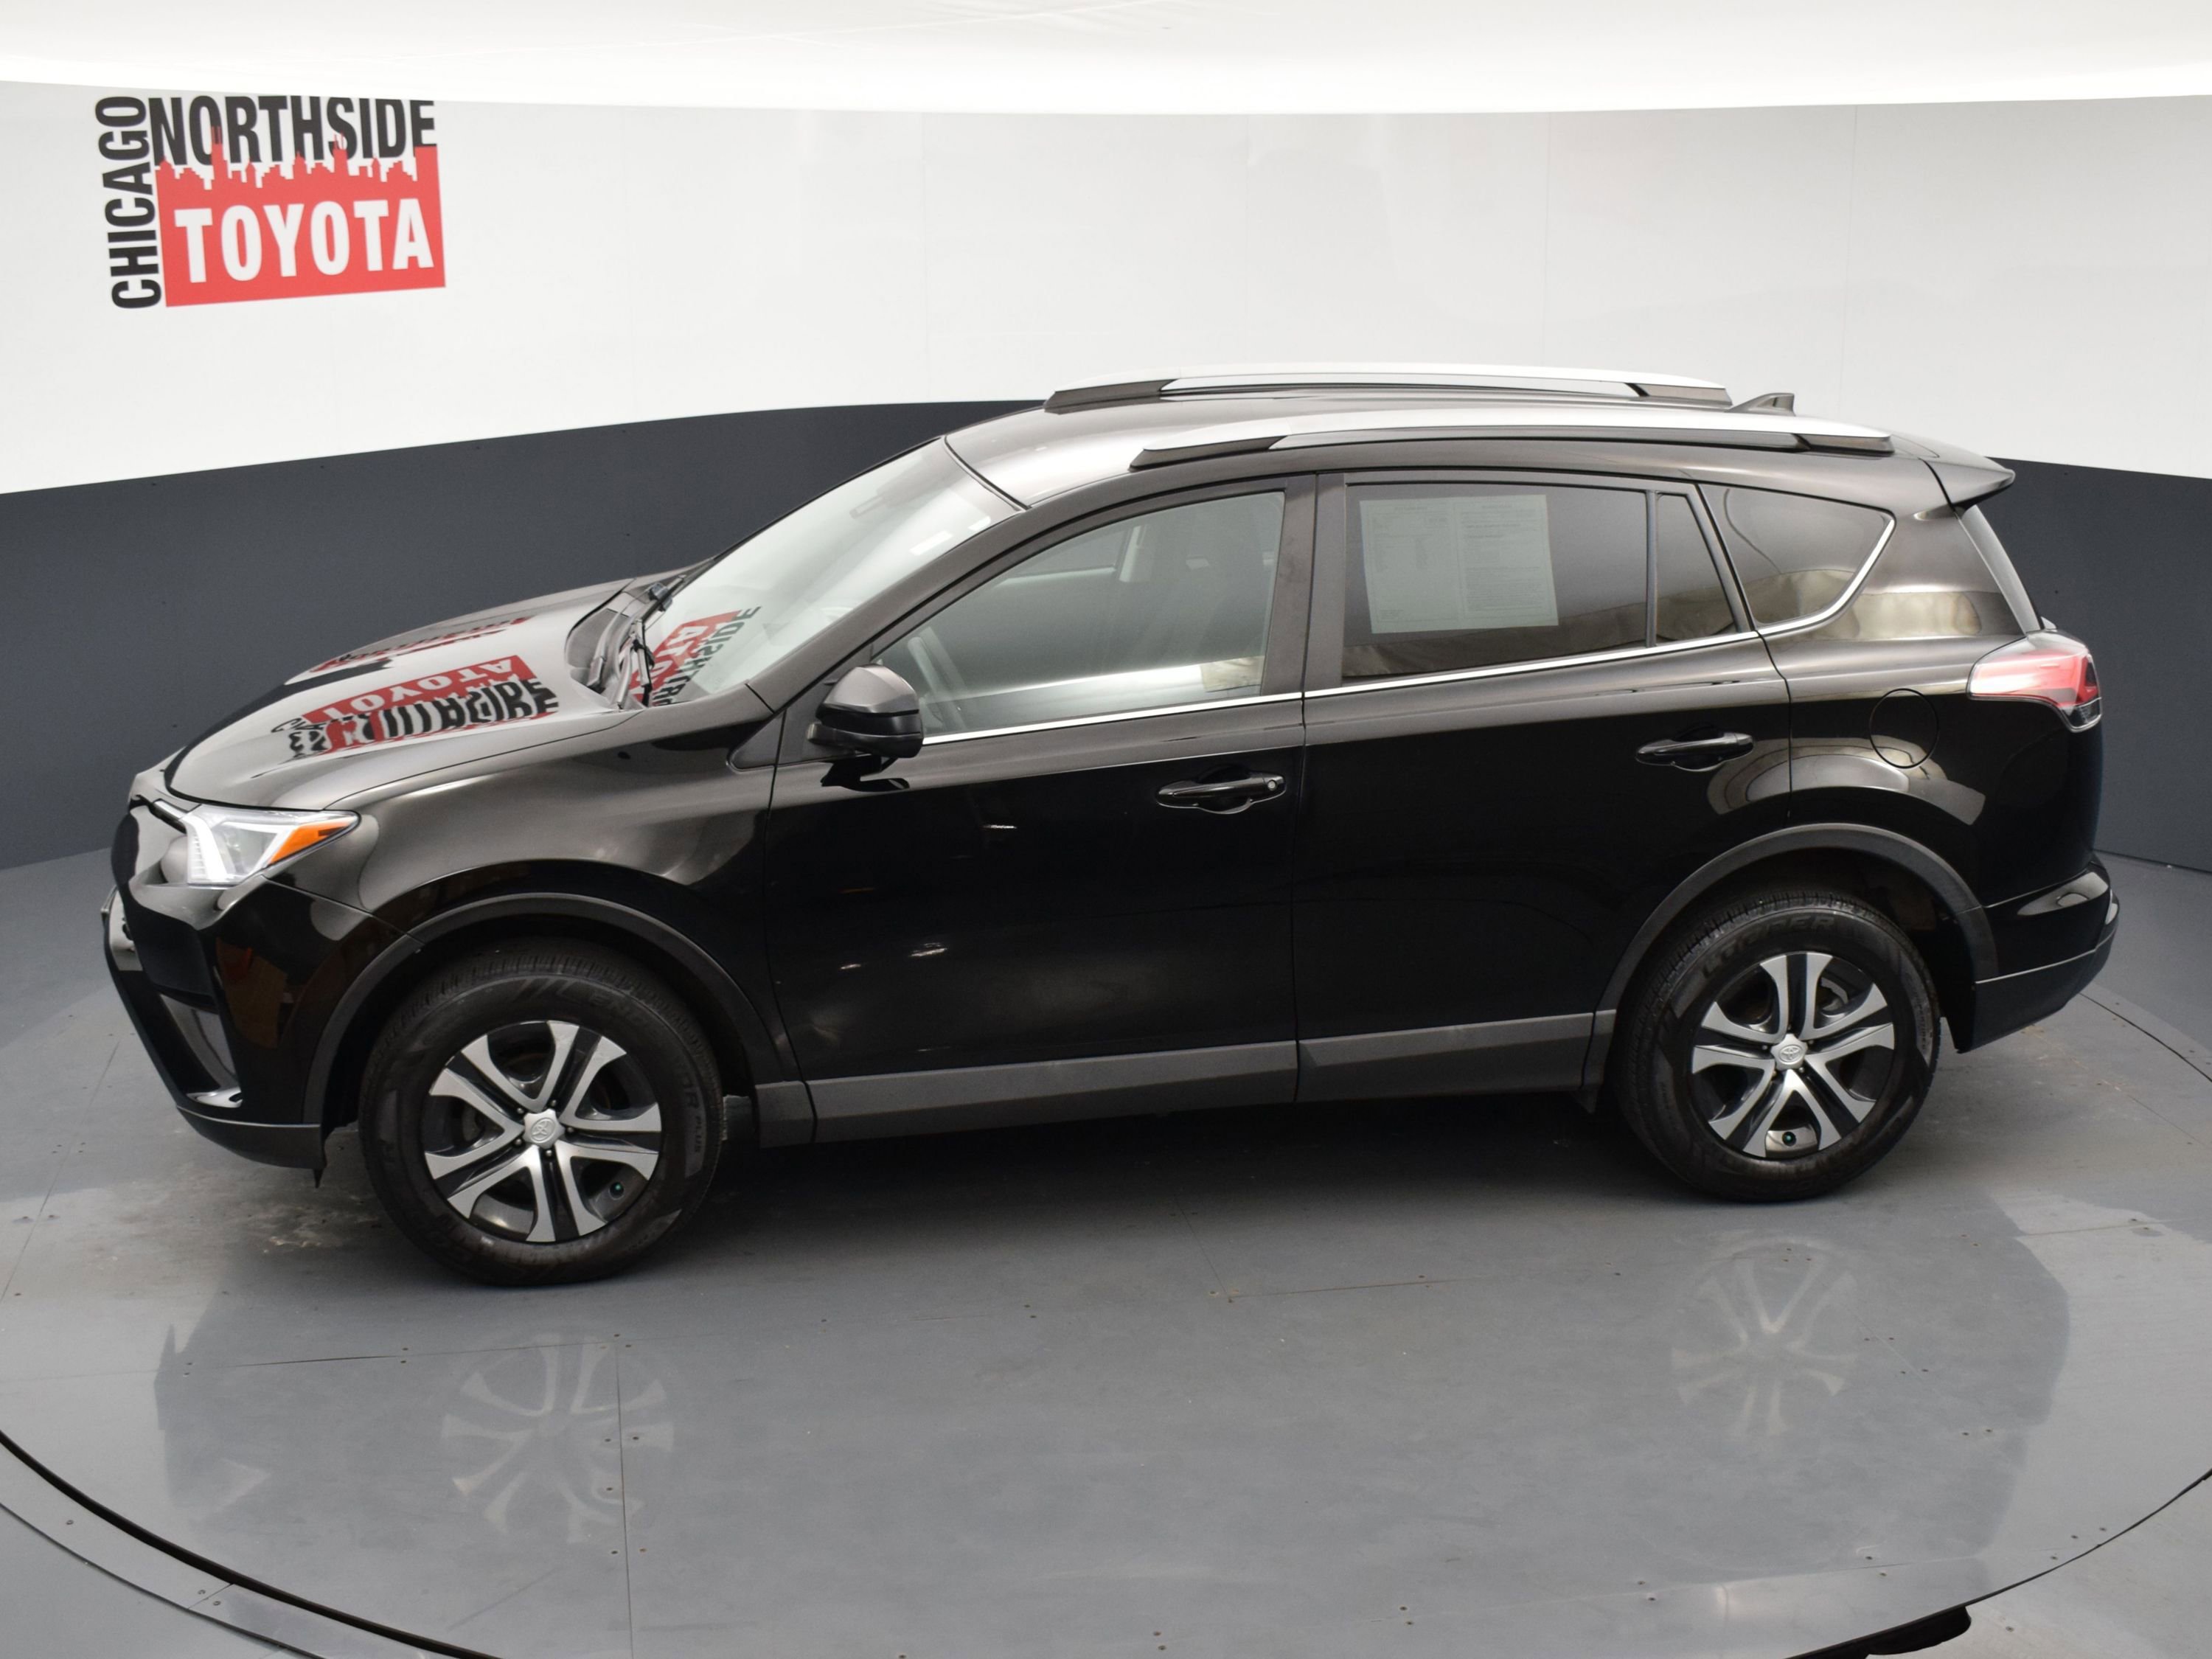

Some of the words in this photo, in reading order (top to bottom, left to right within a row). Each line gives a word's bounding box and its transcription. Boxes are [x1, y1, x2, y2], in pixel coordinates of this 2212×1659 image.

[148, 95, 437, 166] NORTHSIDE
[95, 96, 163, 309] CHICAGO
[174, 198, 435, 283] TOYOTA
